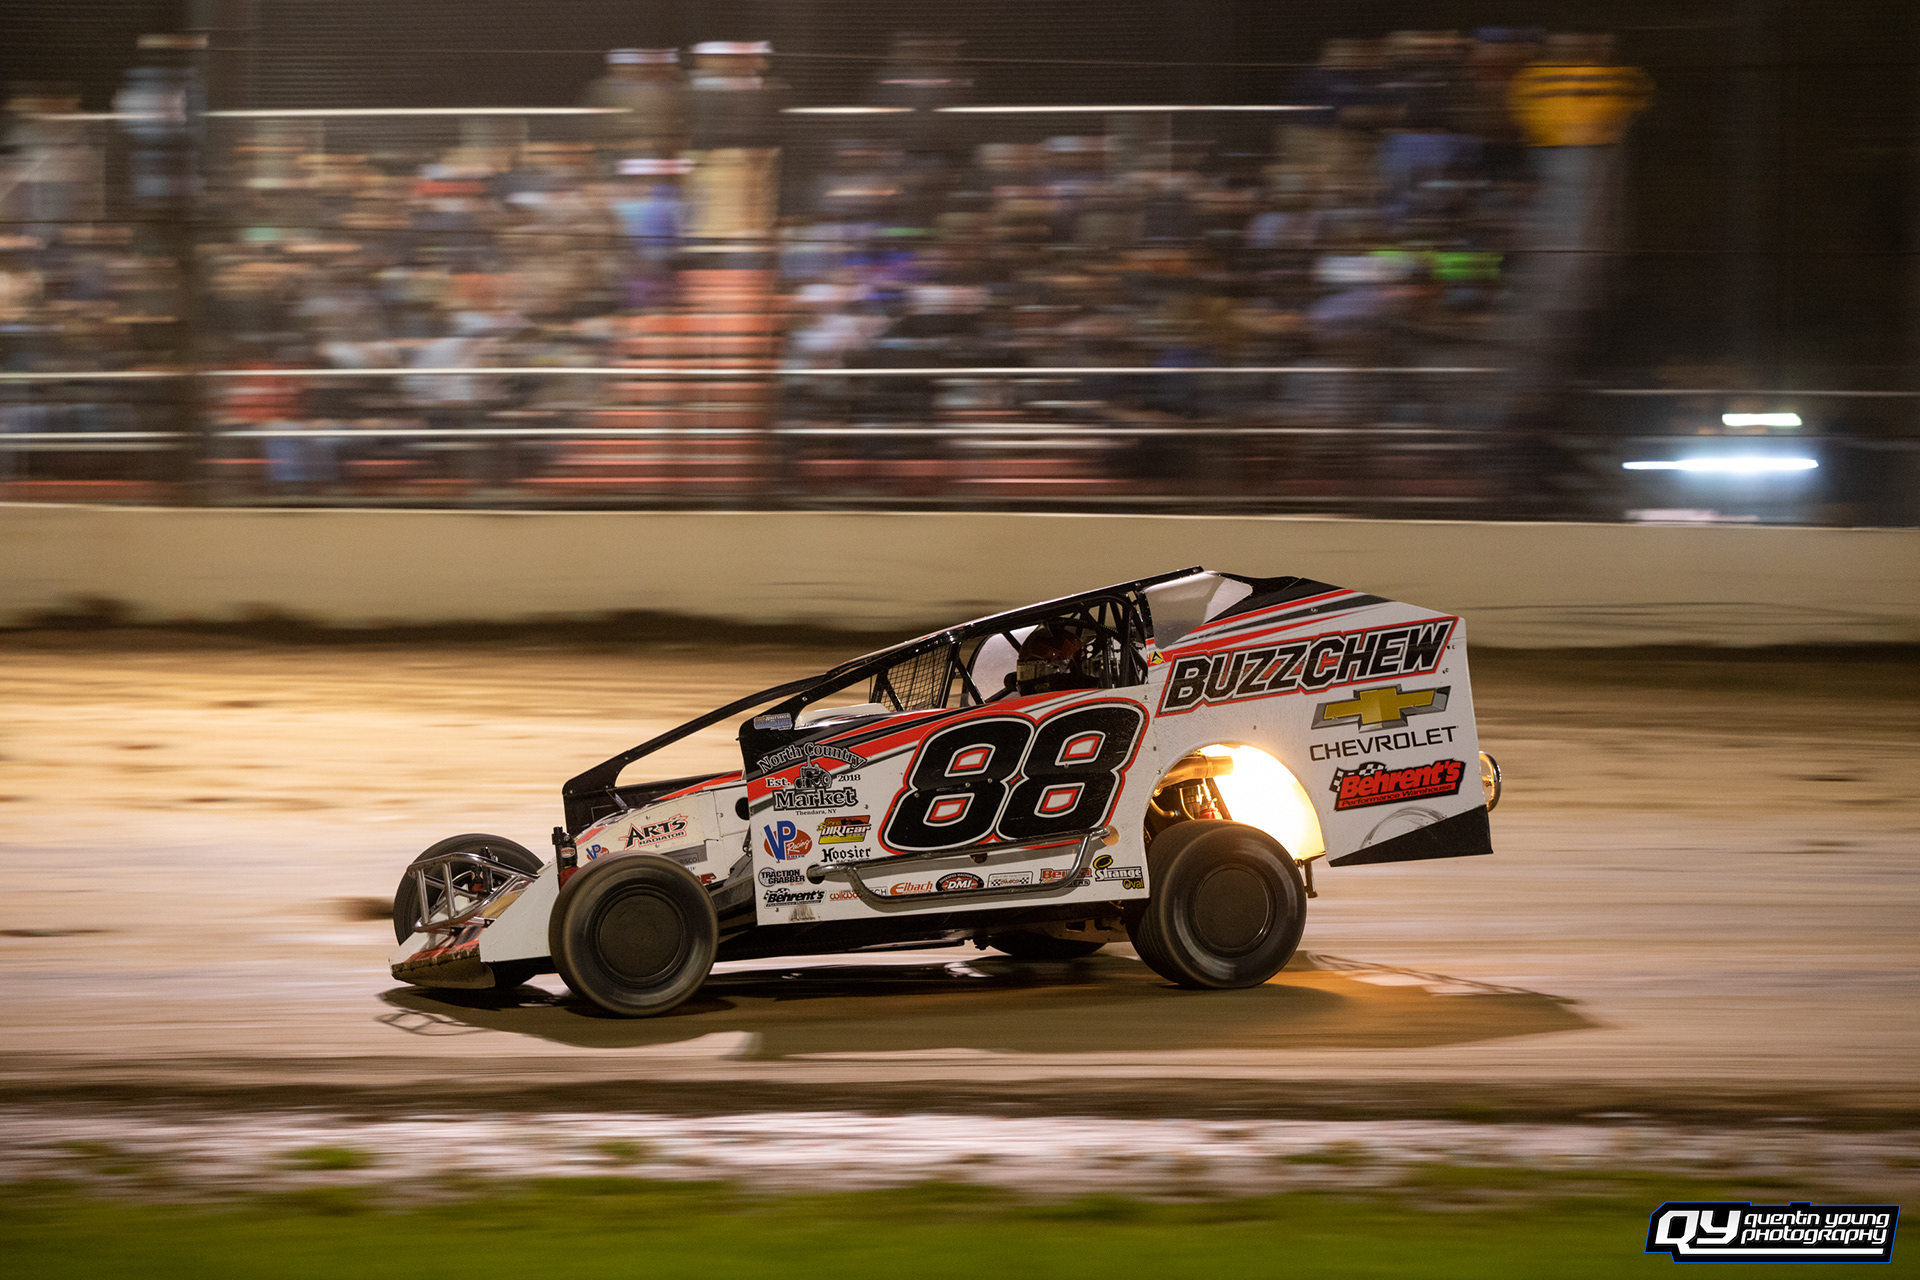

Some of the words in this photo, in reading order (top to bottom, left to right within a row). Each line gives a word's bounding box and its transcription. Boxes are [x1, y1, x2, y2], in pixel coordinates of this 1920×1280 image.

[1158, 619, 1455, 715] BUZZCHEW
[1310, 726, 1457, 761] CHEVROLET
[757, 745, 801, 773] North
[803, 742, 867, 769] Country
[766, 777, 790, 788] Est.
[837, 774, 861, 782] 2018
[881, 698, 1148, 853] 88
[1339, 760, 1462, 799] Behrent's
[774, 788, 858, 810] Market
[1341, 793, 1400, 807] Performance
[1402, 784, 1453, 797] Warehouse
[624, 817, 686, 848] ARTS
[639, 831, 684, 845] RADIATOR
[763, 820, 796, 860] VP
[586, 844, 602, 859] VP
[787, 840, 811, 854] Racing
[820, 846, 871, 862] Hoosier
[761, 869, 800, 879] TRACTION
[768, 875, 806, 884] GRABBER
[1095, 868, 1142, 881] Strange
[947, 880, 972, 890] DMI
[1123, 879, 1144, 889] Oval
[768, 890, 825, 902] Behrent's
